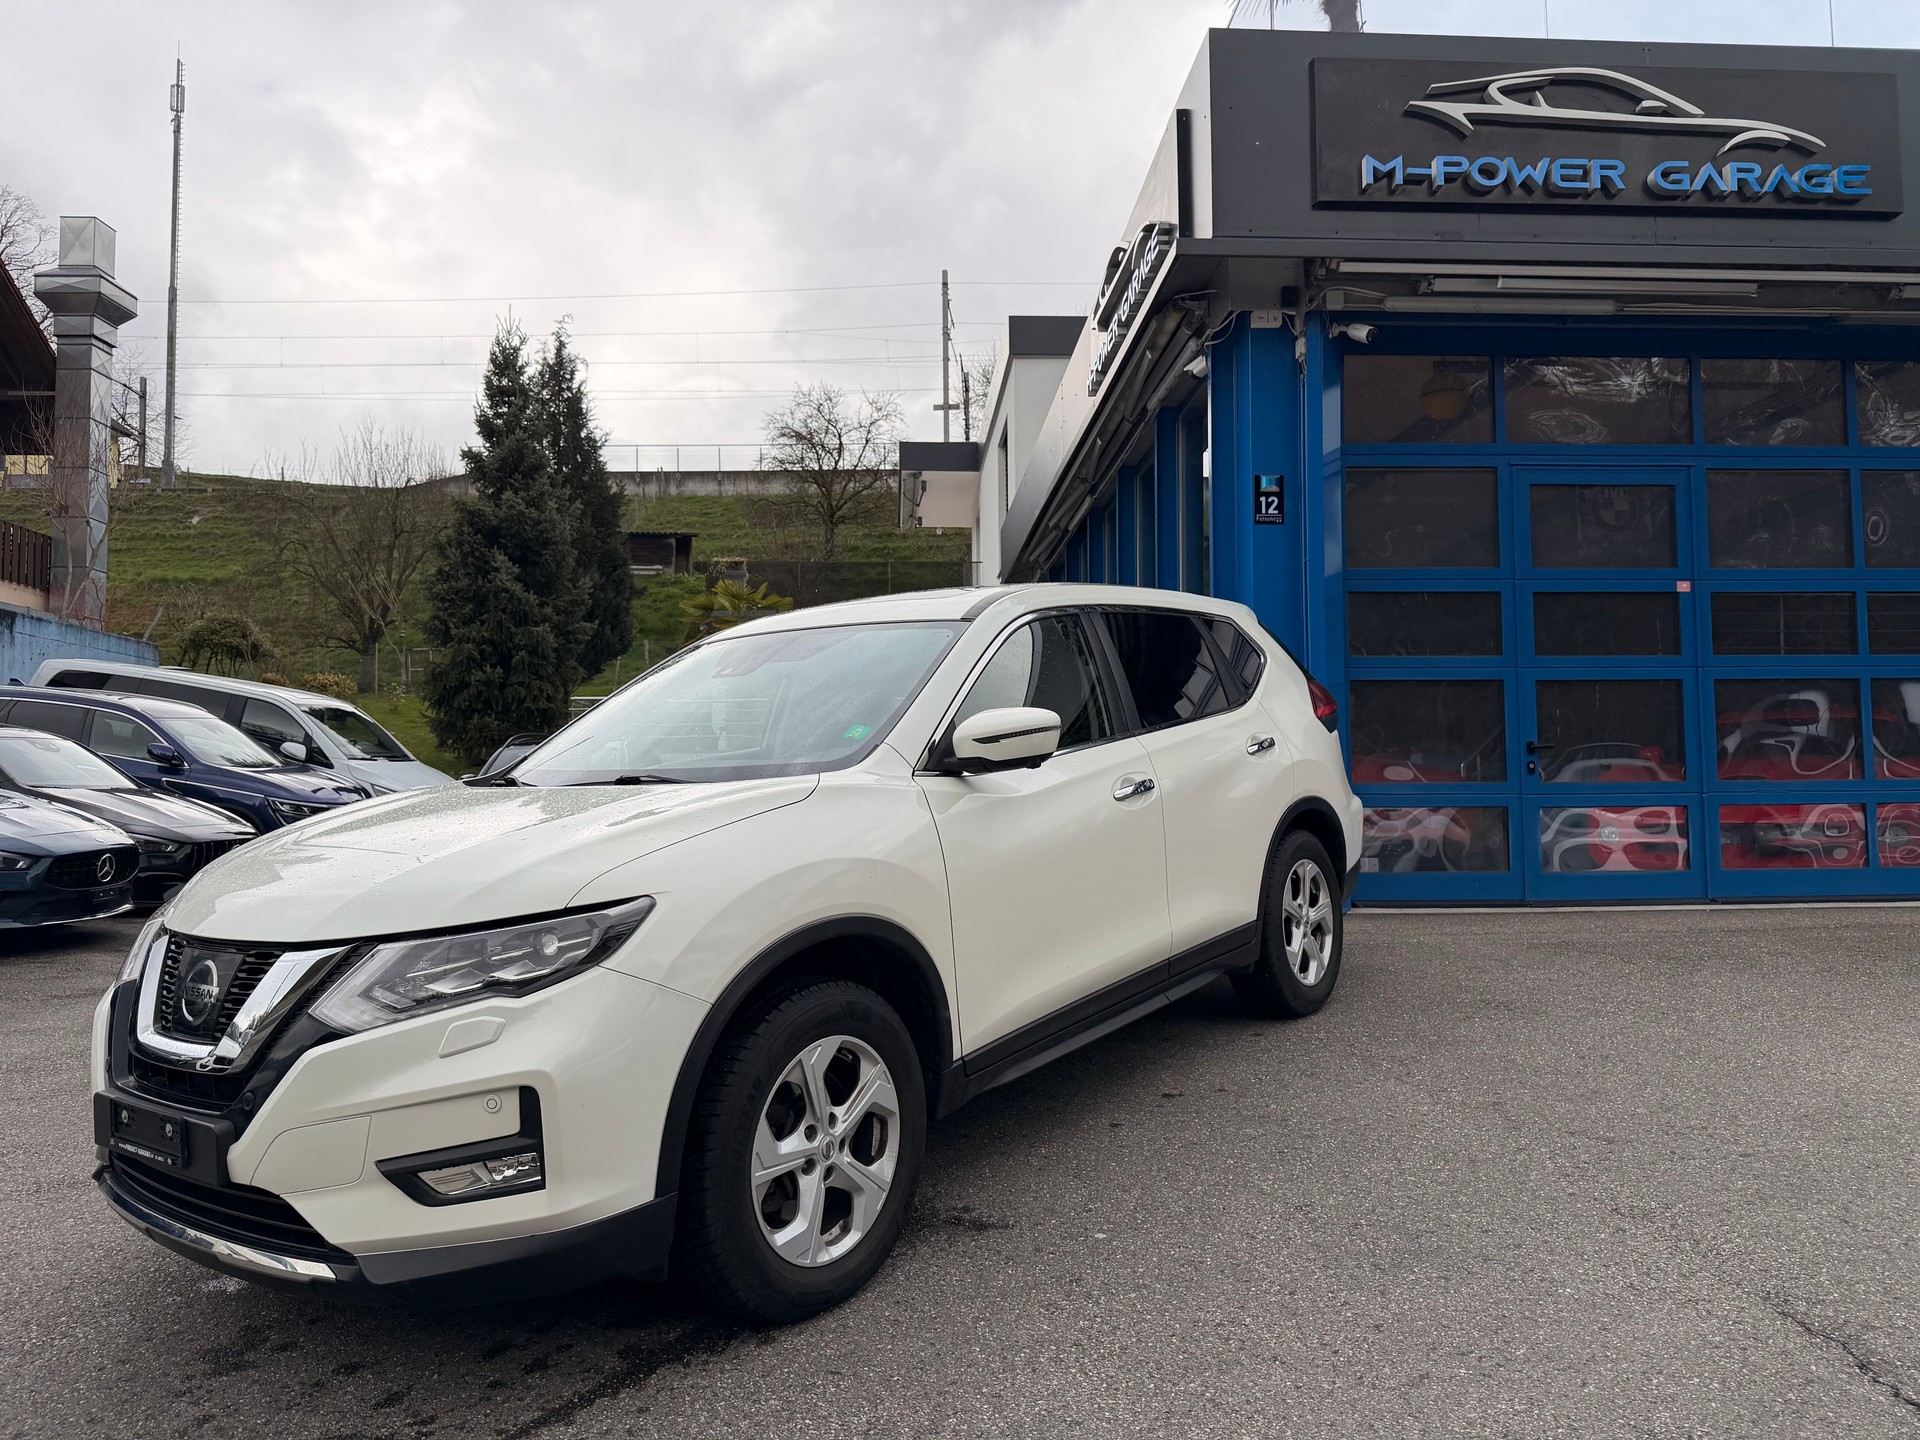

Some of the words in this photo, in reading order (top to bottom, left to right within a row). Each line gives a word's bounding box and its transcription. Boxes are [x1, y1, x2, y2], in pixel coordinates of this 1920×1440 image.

[1362, 153, 1626, 192] M-POWER
[1650, 160, 1873, 197] GARAGE
[1121, 223, 1160, 322] GARAGE
[1259, 496, 1279, 514] 12
[183, 986, 214, 1000] NISSAN
